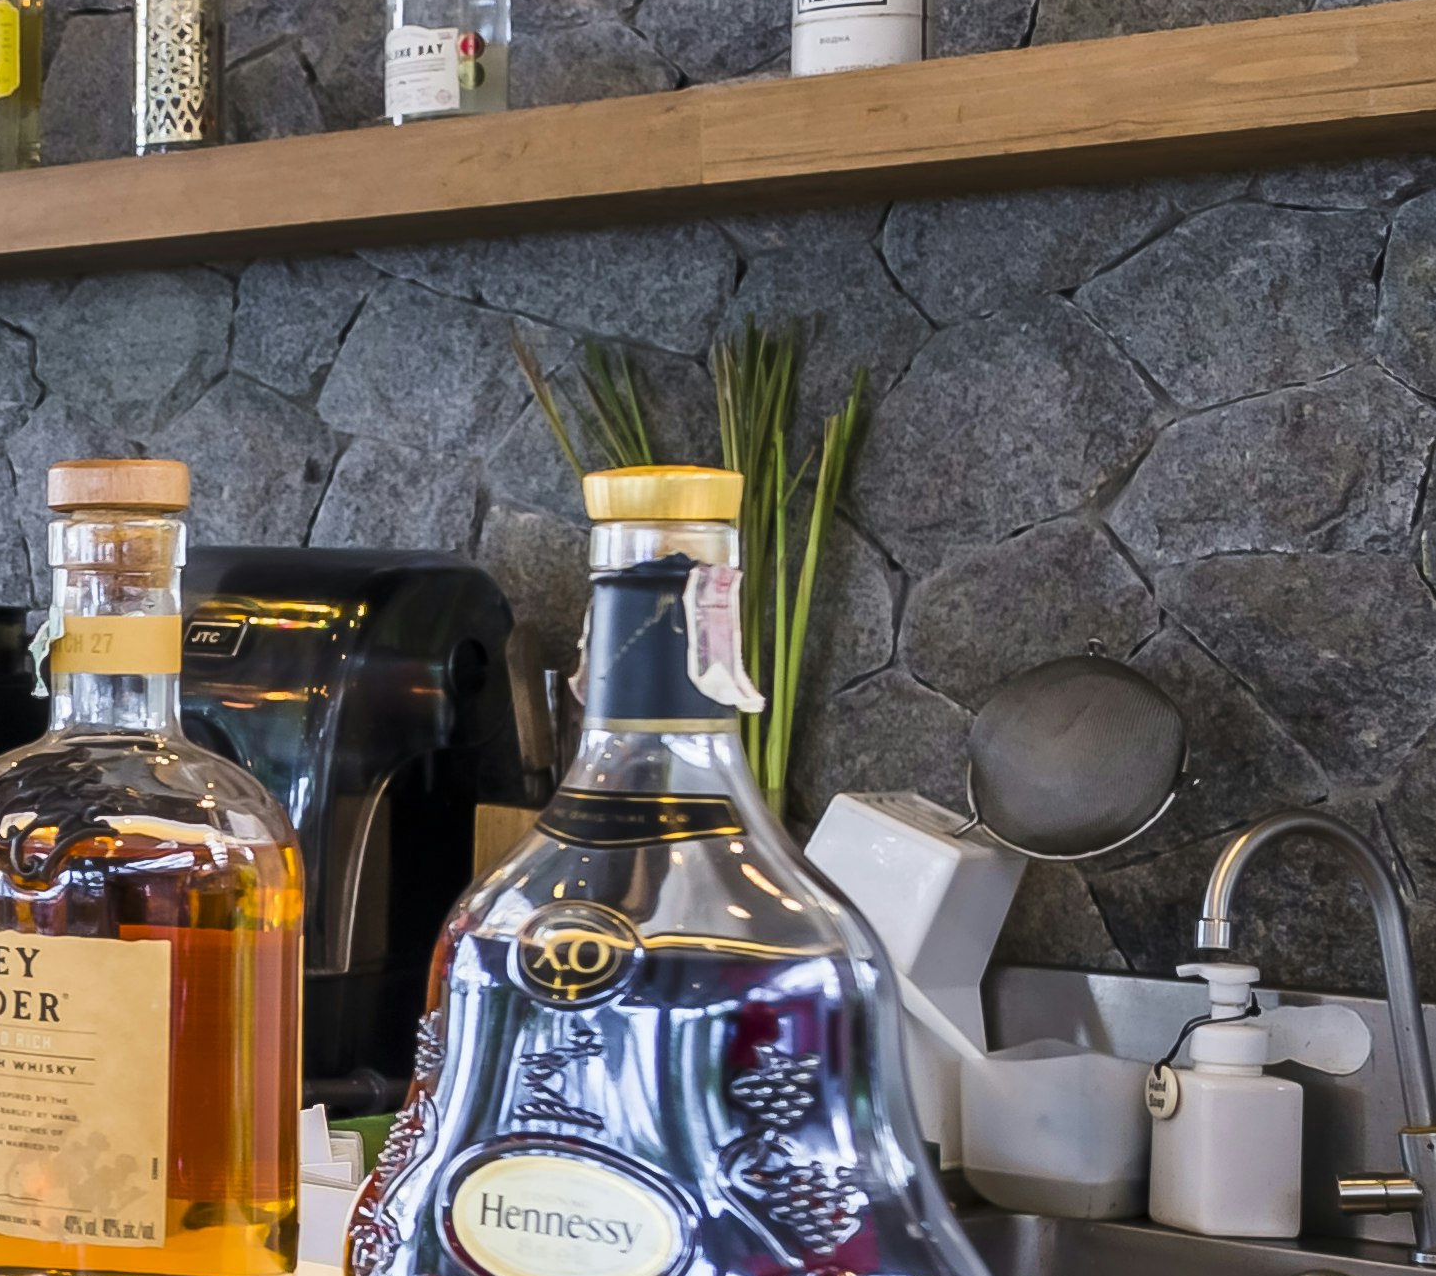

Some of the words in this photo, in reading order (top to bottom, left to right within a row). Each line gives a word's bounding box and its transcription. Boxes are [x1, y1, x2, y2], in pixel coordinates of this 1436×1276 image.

[90, 633, 115, 654] 27
[191, 631, 221, 643] JTC
[15, 1033, 53, 1050] RICH
[12, 1060, 77, 1075] WHISKY
[479, 1191, 643, 1255] Hennessy
